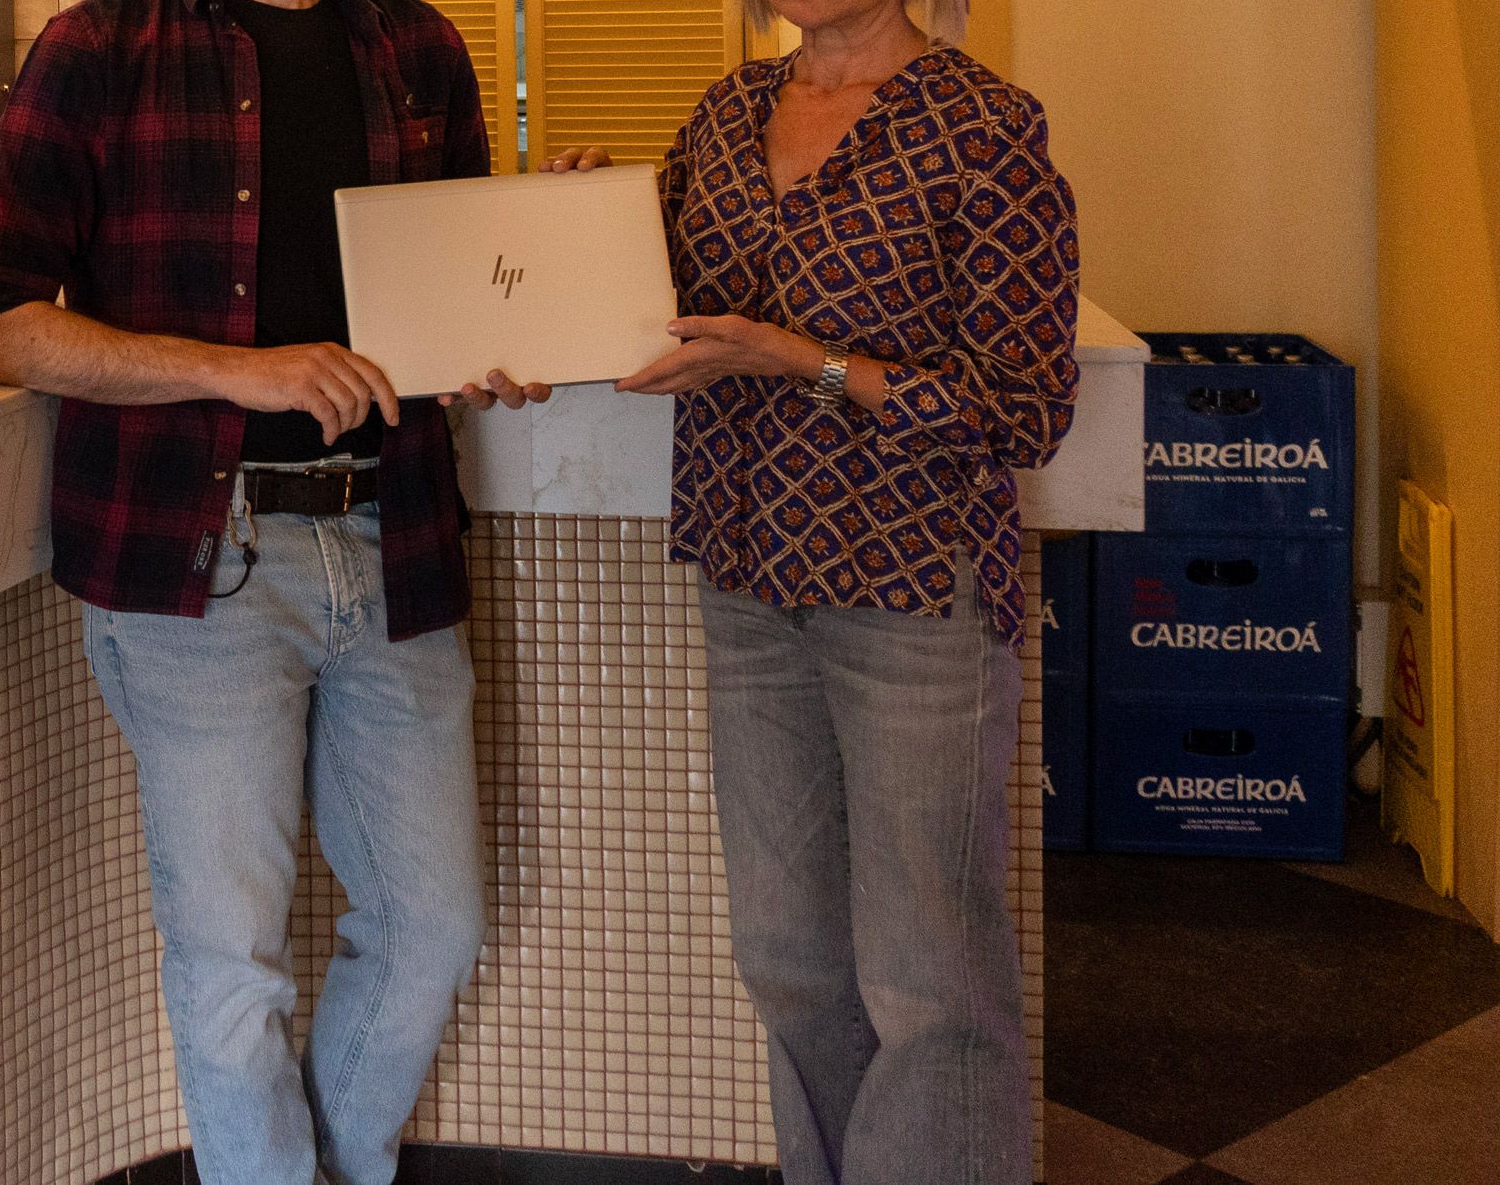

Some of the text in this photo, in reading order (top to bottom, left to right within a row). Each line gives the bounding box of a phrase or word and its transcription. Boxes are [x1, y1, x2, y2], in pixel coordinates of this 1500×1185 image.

[491, 254, 524, 300] hp
[1173, 474, 1211, 483] MINERAL
[1213, 475, 1254, 484] NATURAL
[1270, 476, 1306, 484] GALICIA
